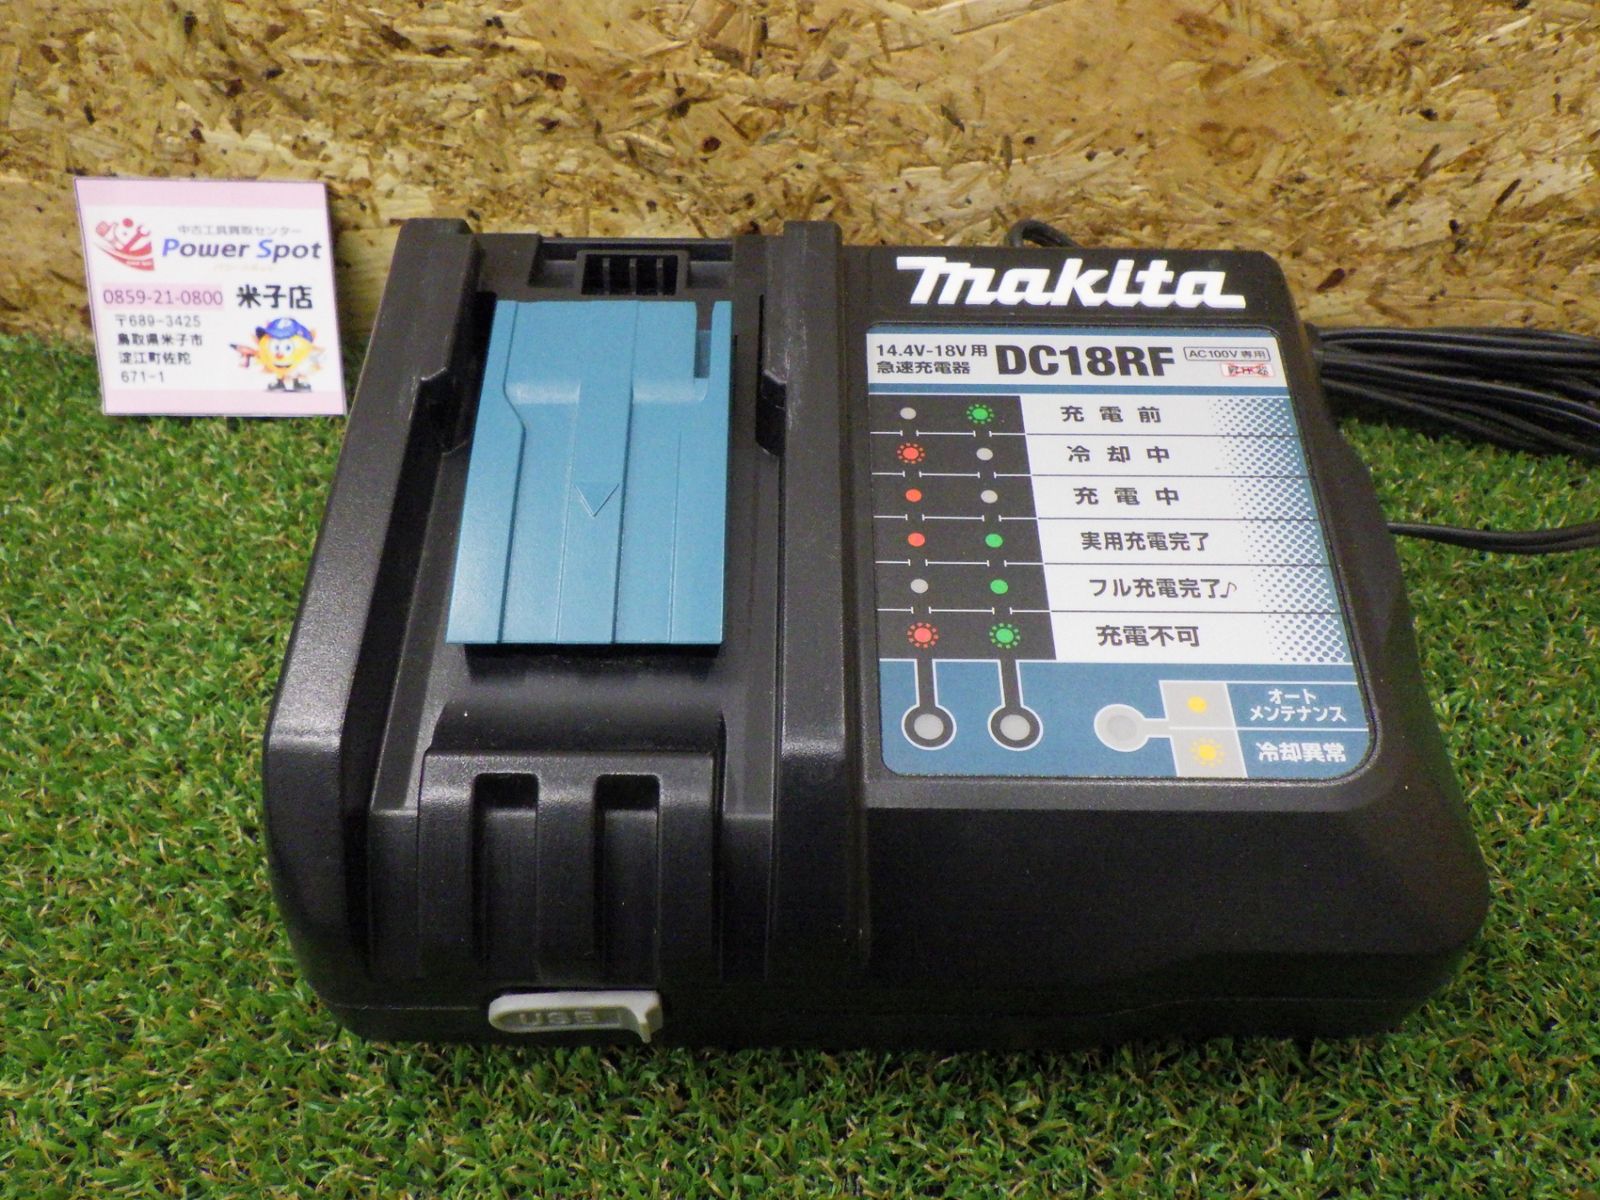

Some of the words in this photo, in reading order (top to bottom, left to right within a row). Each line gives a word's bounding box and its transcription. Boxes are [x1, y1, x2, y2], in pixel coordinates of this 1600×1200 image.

[162, 238, 249, 257] Power
[256, 239, 322, 263] Spot
[103, 289, 223, 305] 0859-21-0800
[236, 284, 313, 309] 米子店
[117, 333, 203, 346] 鳥取県米子市
[876, 361, 971, 375] 急速充電器
[995, 344, 1175, 377] DC18RF
[121, 371, 164, 383] 671-1
[1080, 531, 1209, 551] 実用充電完了
[1096, 625, 1200, 647] 充電不可
[1268, 688, 1316, 705] オート
[1250, 705, 1347, 722] メンテナンス
[1255, 742, 1347, 763] 冷却異常
[519, 1012, 594, 1026] USB
